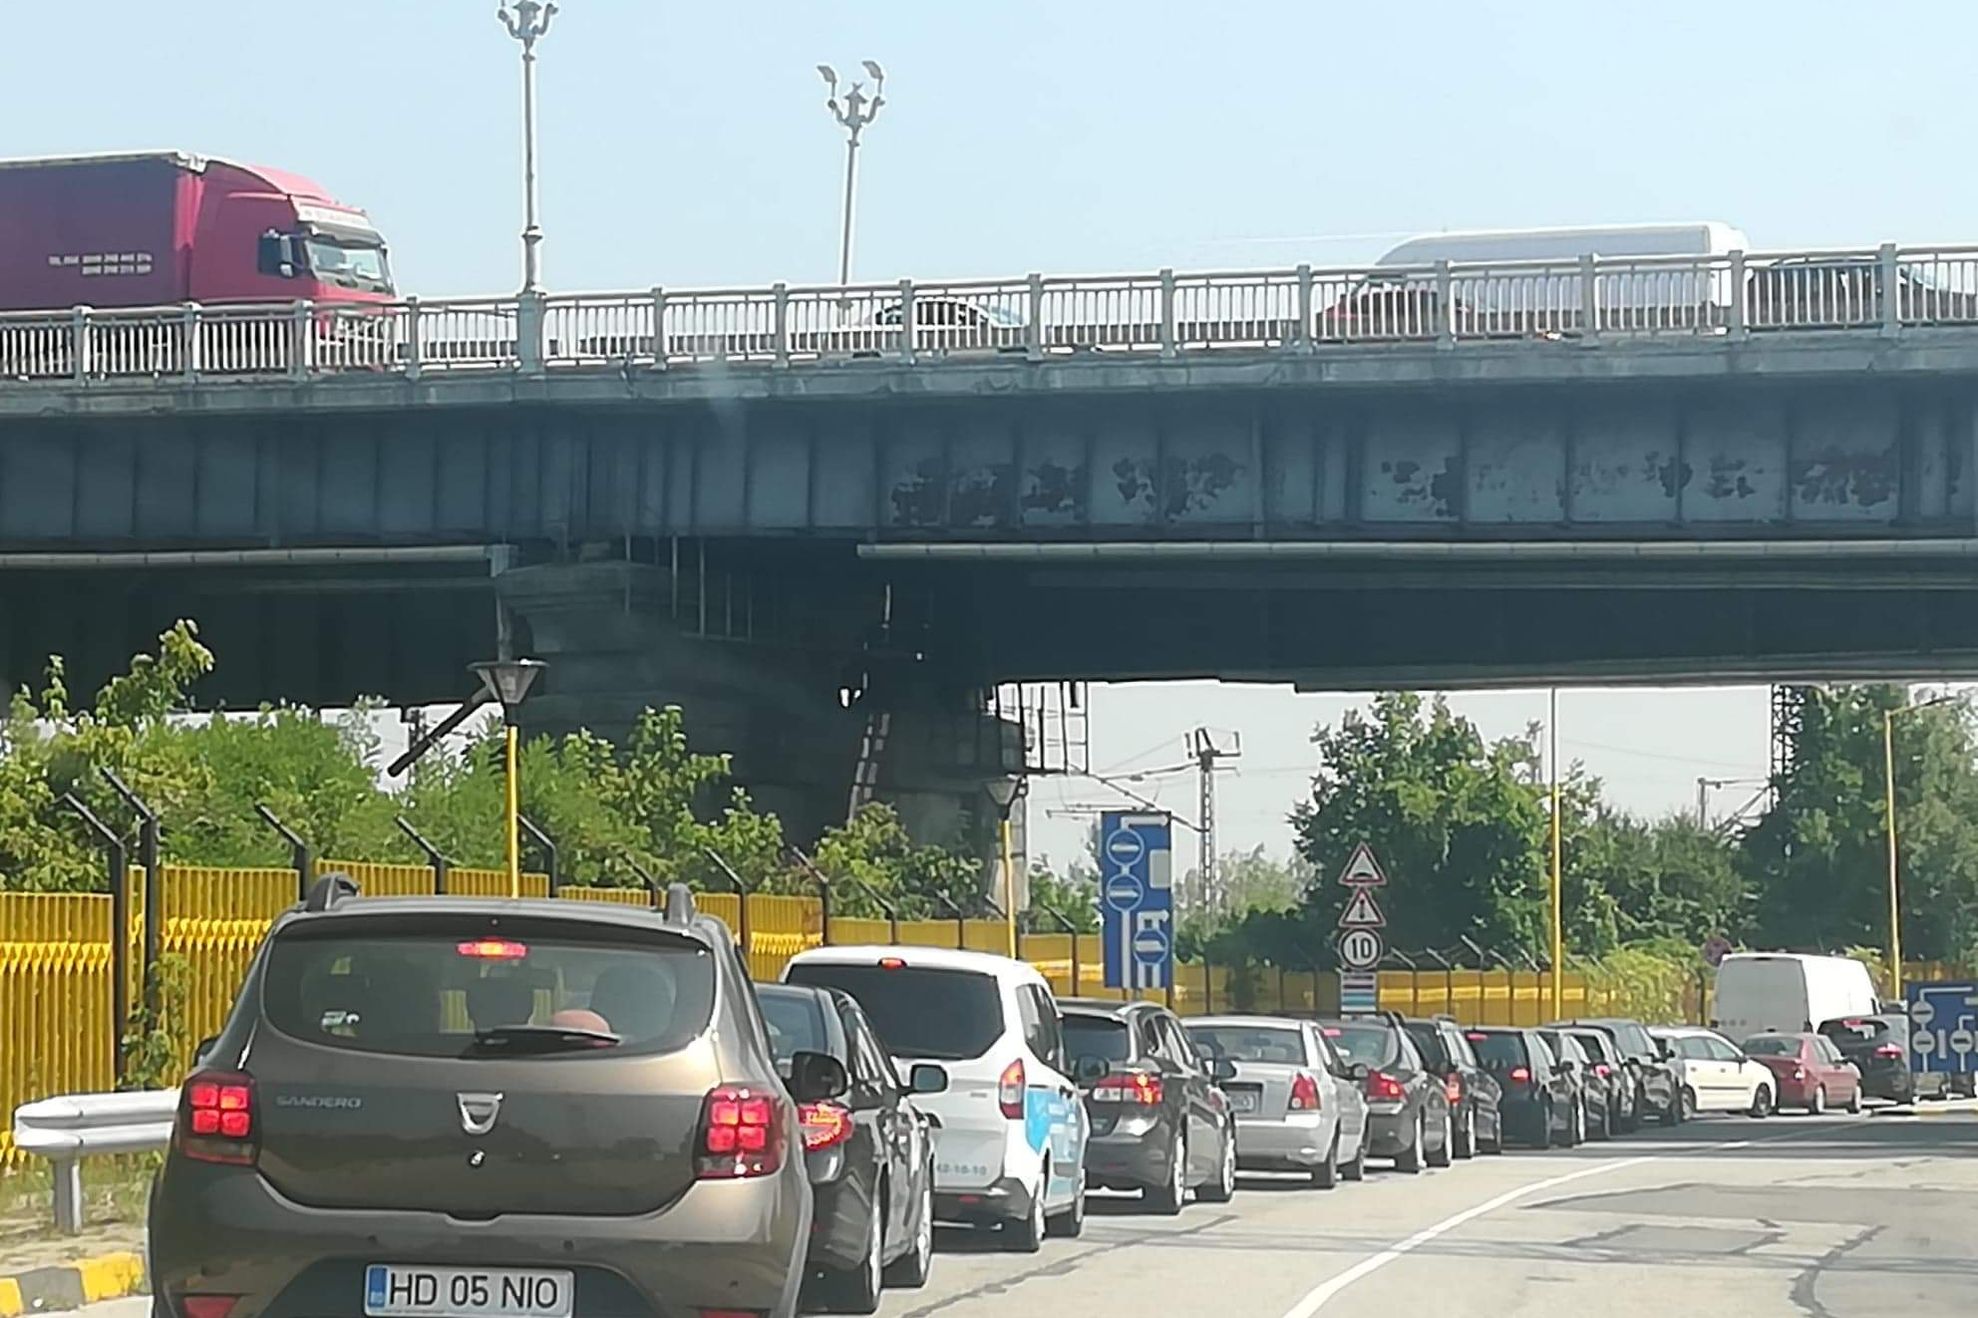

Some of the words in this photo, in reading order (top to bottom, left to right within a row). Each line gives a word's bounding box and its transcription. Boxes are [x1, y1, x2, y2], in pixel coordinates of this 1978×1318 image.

[1351, 938, 1372, 959] 10
[276, 1096, 361, 1108] SANDERO
[389, 1273, 437, 1306] HD
[451, 1275, 488, 1307] 05
[501, 1276, 558, 1309] NIO
